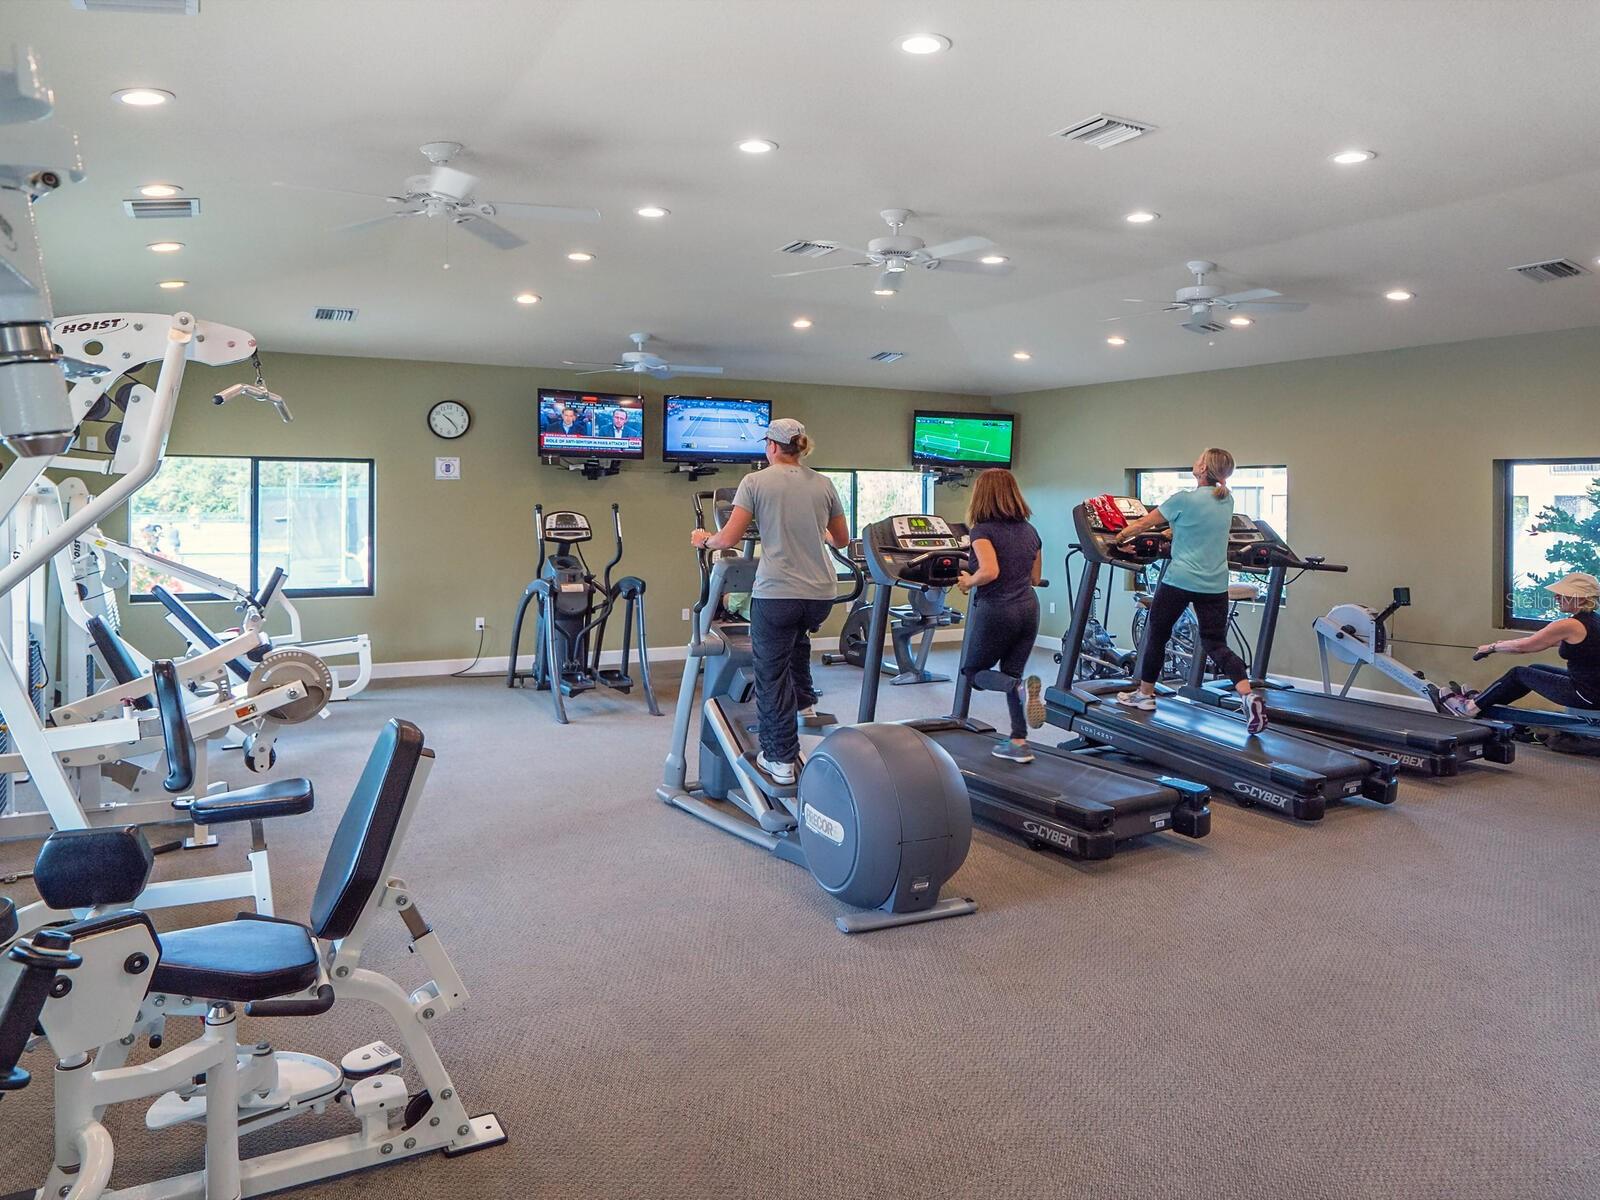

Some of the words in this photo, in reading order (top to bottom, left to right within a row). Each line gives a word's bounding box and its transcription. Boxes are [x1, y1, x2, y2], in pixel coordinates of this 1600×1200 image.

[61, 318, 121, 334] HOIST
[1250, 786, 1288, 808] CYBEX
[806, 807, 834, 837] PRECOR
[1037, 824, 1074, 848] CYBEX
